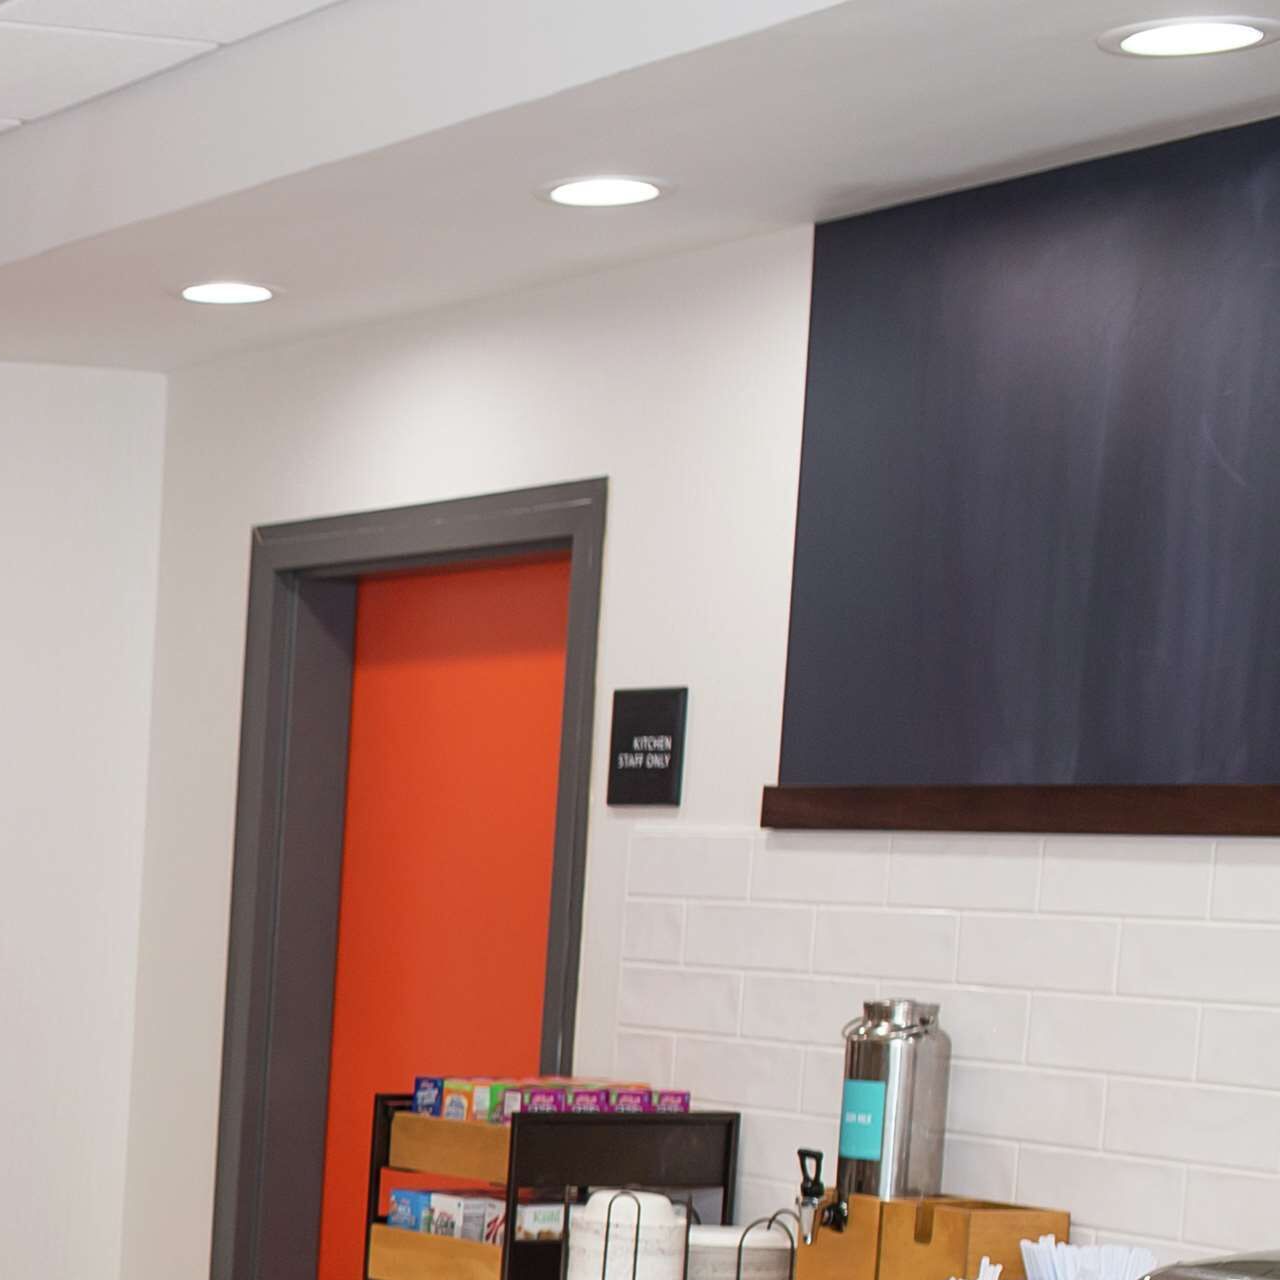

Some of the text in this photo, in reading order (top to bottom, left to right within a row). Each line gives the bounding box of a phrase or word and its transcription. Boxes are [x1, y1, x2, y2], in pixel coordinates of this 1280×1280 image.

[633, 735, 672, 751] KITCHEN
[618, 752, 671, 769] STAFF ONLY
